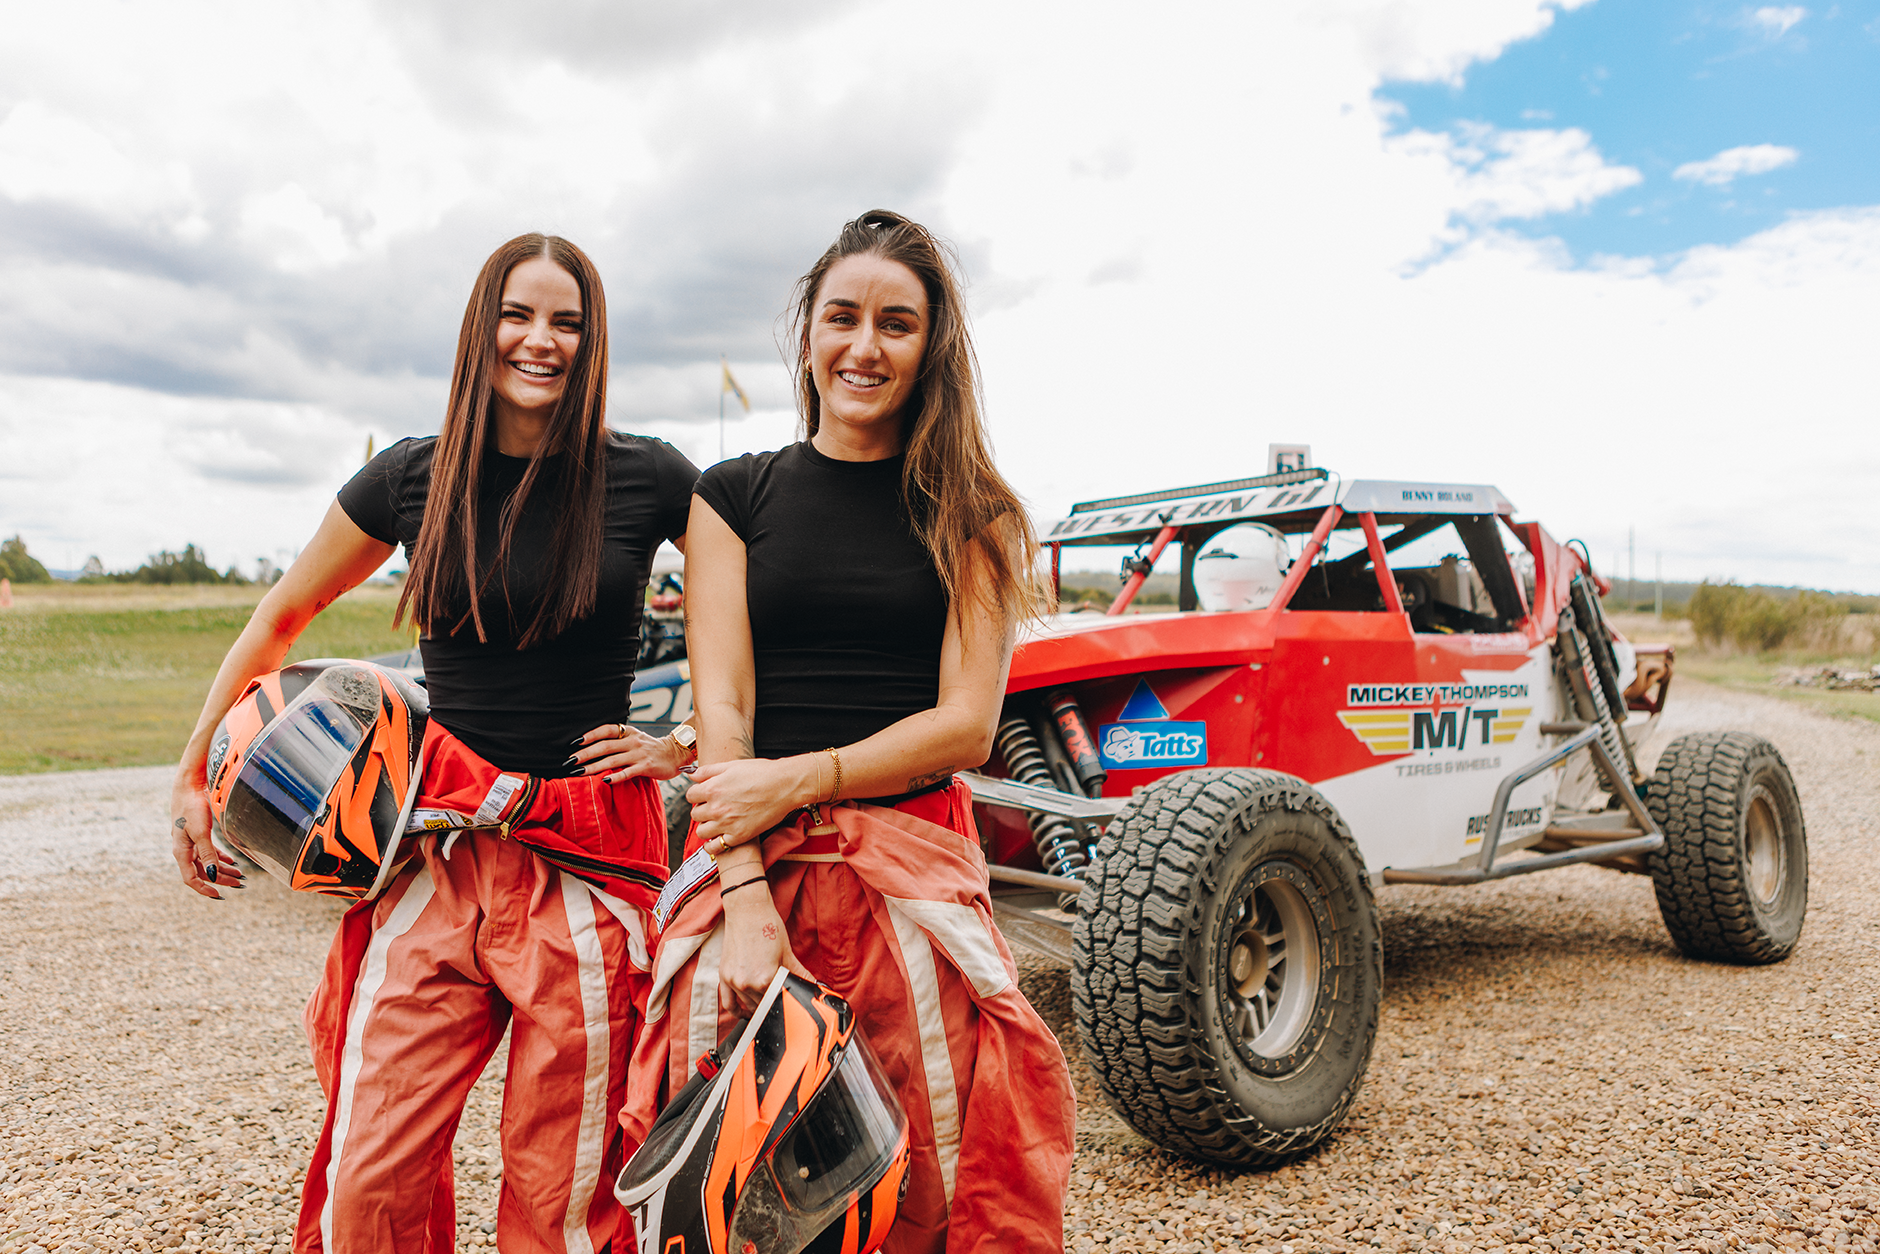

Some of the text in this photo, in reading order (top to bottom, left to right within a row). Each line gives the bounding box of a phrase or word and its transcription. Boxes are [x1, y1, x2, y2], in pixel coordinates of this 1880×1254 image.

[1050, 494, 1257, 537] WESTERN
[1350, 684, 1528, 702] MICKEY THOMPSON
[1057, 710, 1093, 763] FOX
[1413, 706, 1498, 751] M/T
[1139, 735, 1198, 757] Tatts
[1395, 757, 1501, 777] TIRES & WHEELS
[1506, 807, 1542, 829] RUCKS
